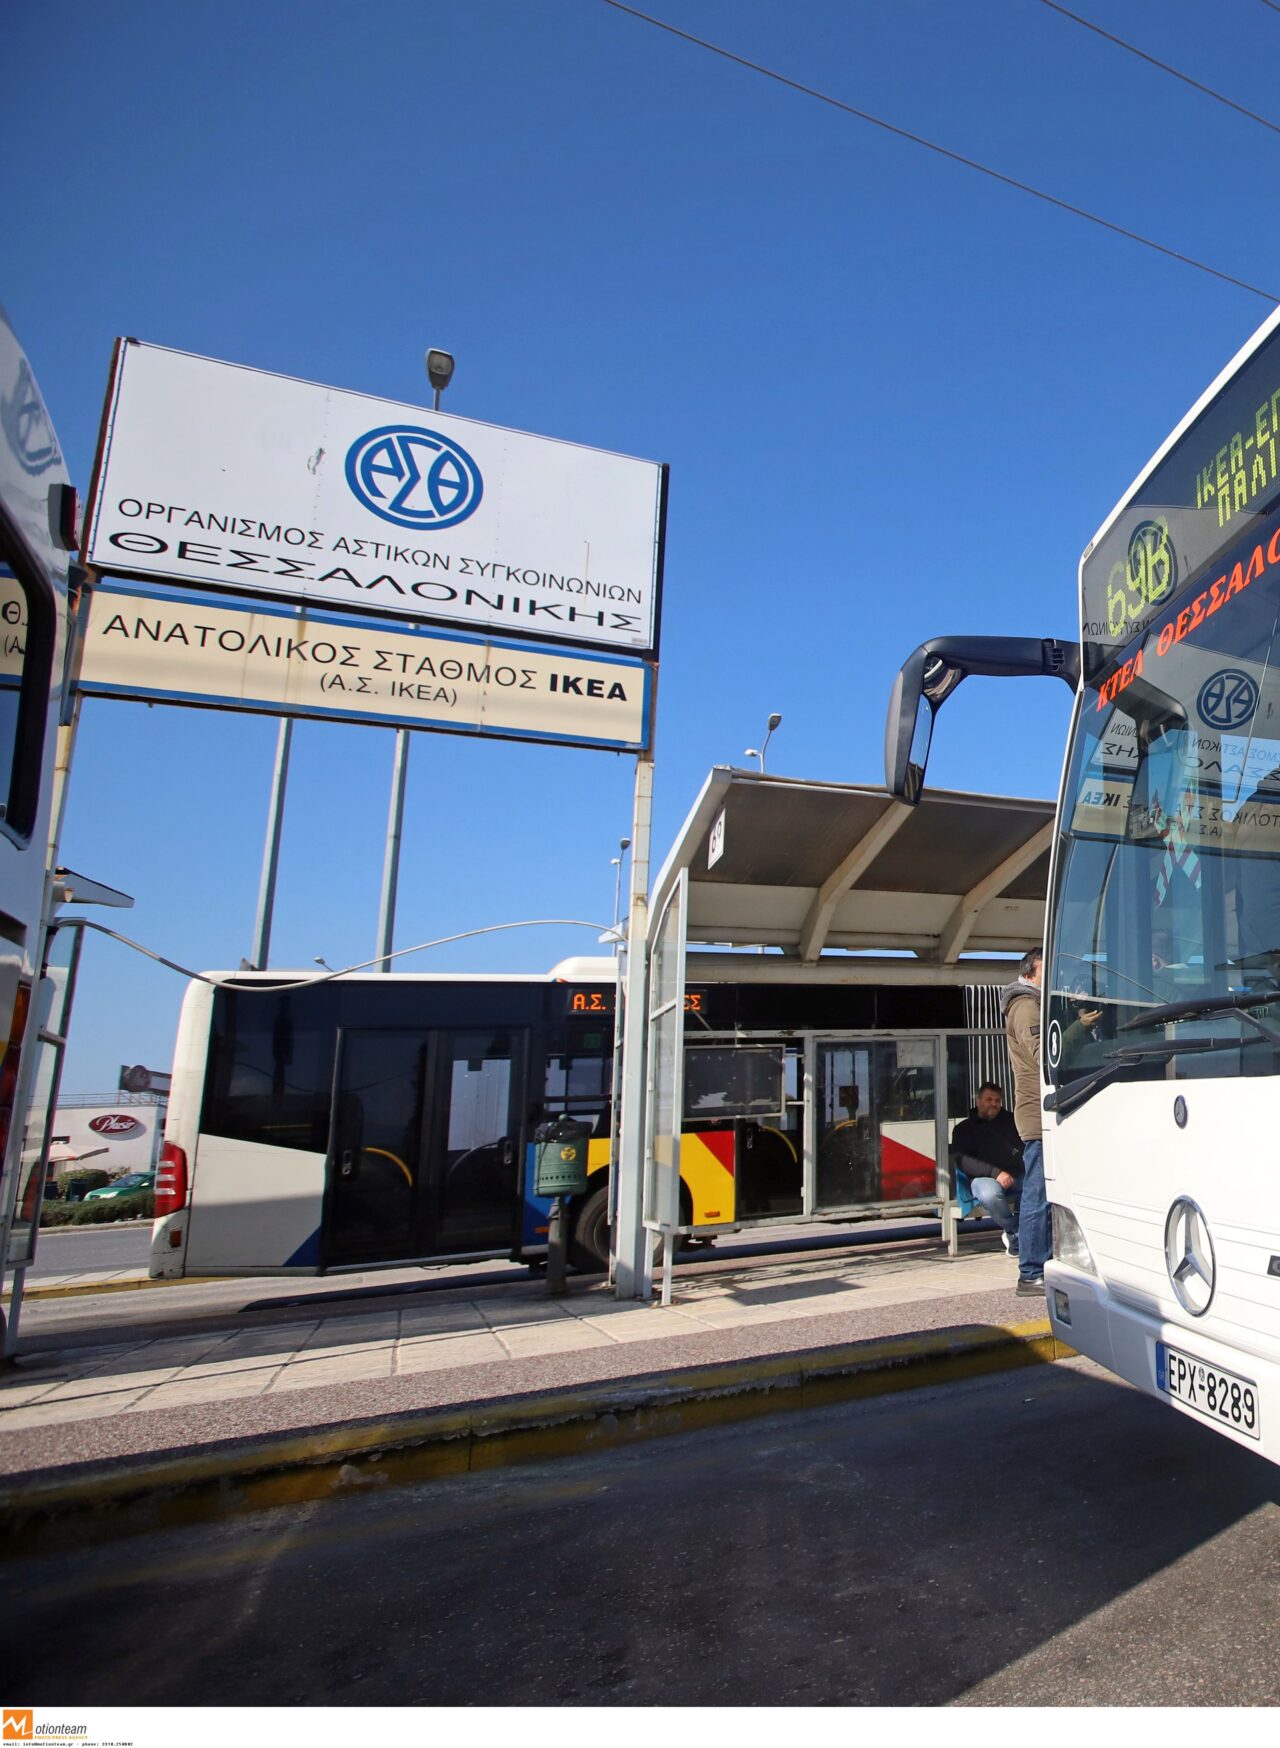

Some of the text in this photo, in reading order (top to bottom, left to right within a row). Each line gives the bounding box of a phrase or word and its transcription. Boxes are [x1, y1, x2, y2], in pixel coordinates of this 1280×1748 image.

[109, 532, 642, 633] ΘΕΣΣΑΛΟΝΙΚΗΣ
[118, 498, 642, 605] ΟΡΓΑΝΙΣΜΟΣ ΑΣΤΙΚΩΝ ΣΥΓΚΟΙΝΩΝΙΩΝ
[102, 614, 361, 667] ΑΝΑΤΟΛΙΚΟΣ
[373, 650, 538, 690] ΣΤΑΘΜΟΣ
[320, 672, 378, 695] (Α.Σ.
[1096, 649, 1144, 713] ΚΤΕΛ
